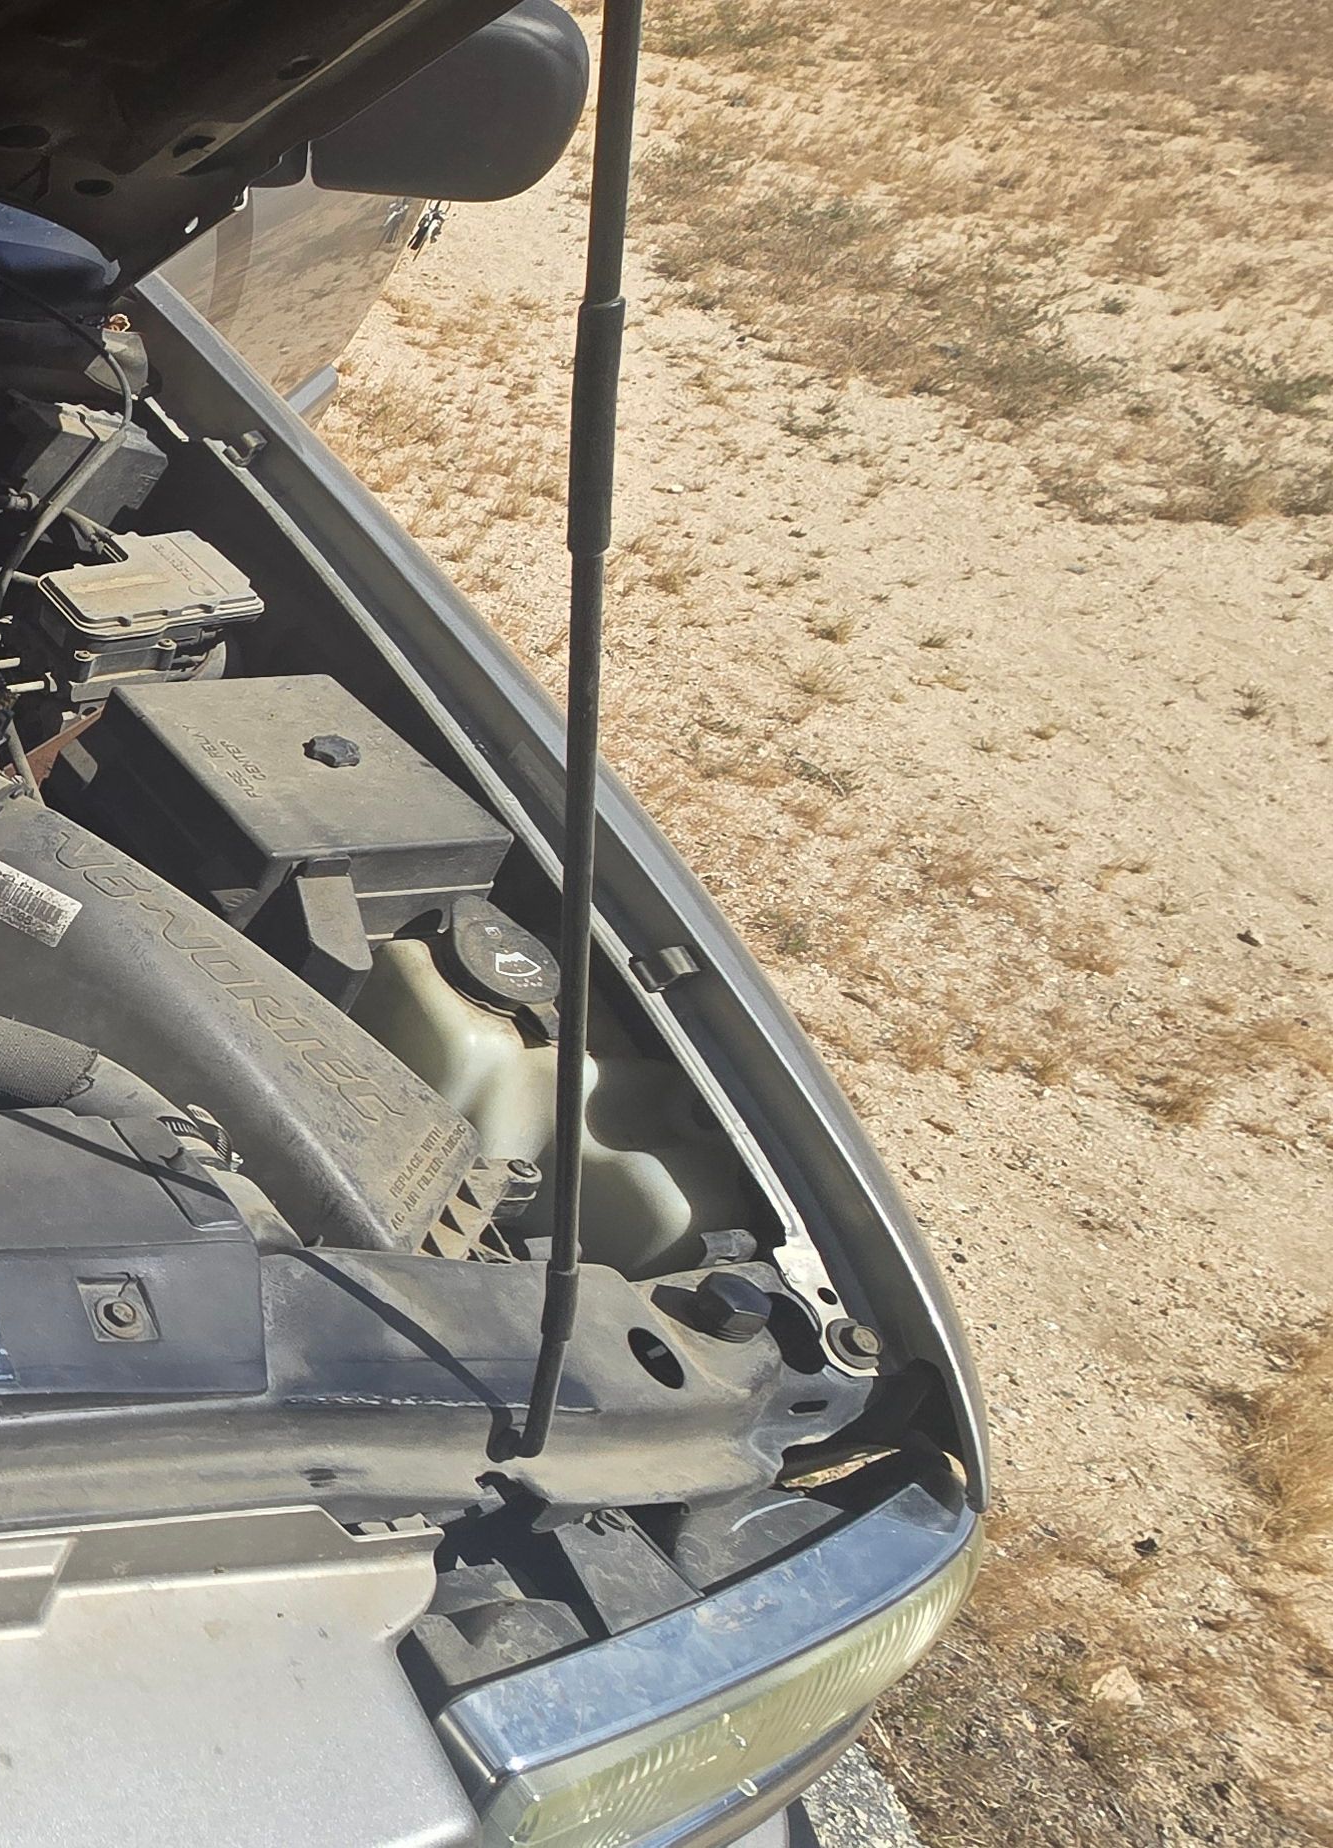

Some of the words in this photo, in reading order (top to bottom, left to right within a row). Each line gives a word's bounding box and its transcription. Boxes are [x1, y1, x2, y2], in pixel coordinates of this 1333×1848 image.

[181, 725, 224, 758] RELAY
[219, 741, 266, 780] CENTER
[225, 770, 263, 798] FUSE
[389, 1152, 425, 1198] REPLACE
[420, 1126, 443, 1153] WITH
[390, 1212, 406, 1231] AC
[402, 1190, 421, 1212] AIR
[416, 1157, 445, 1191] FILTER
